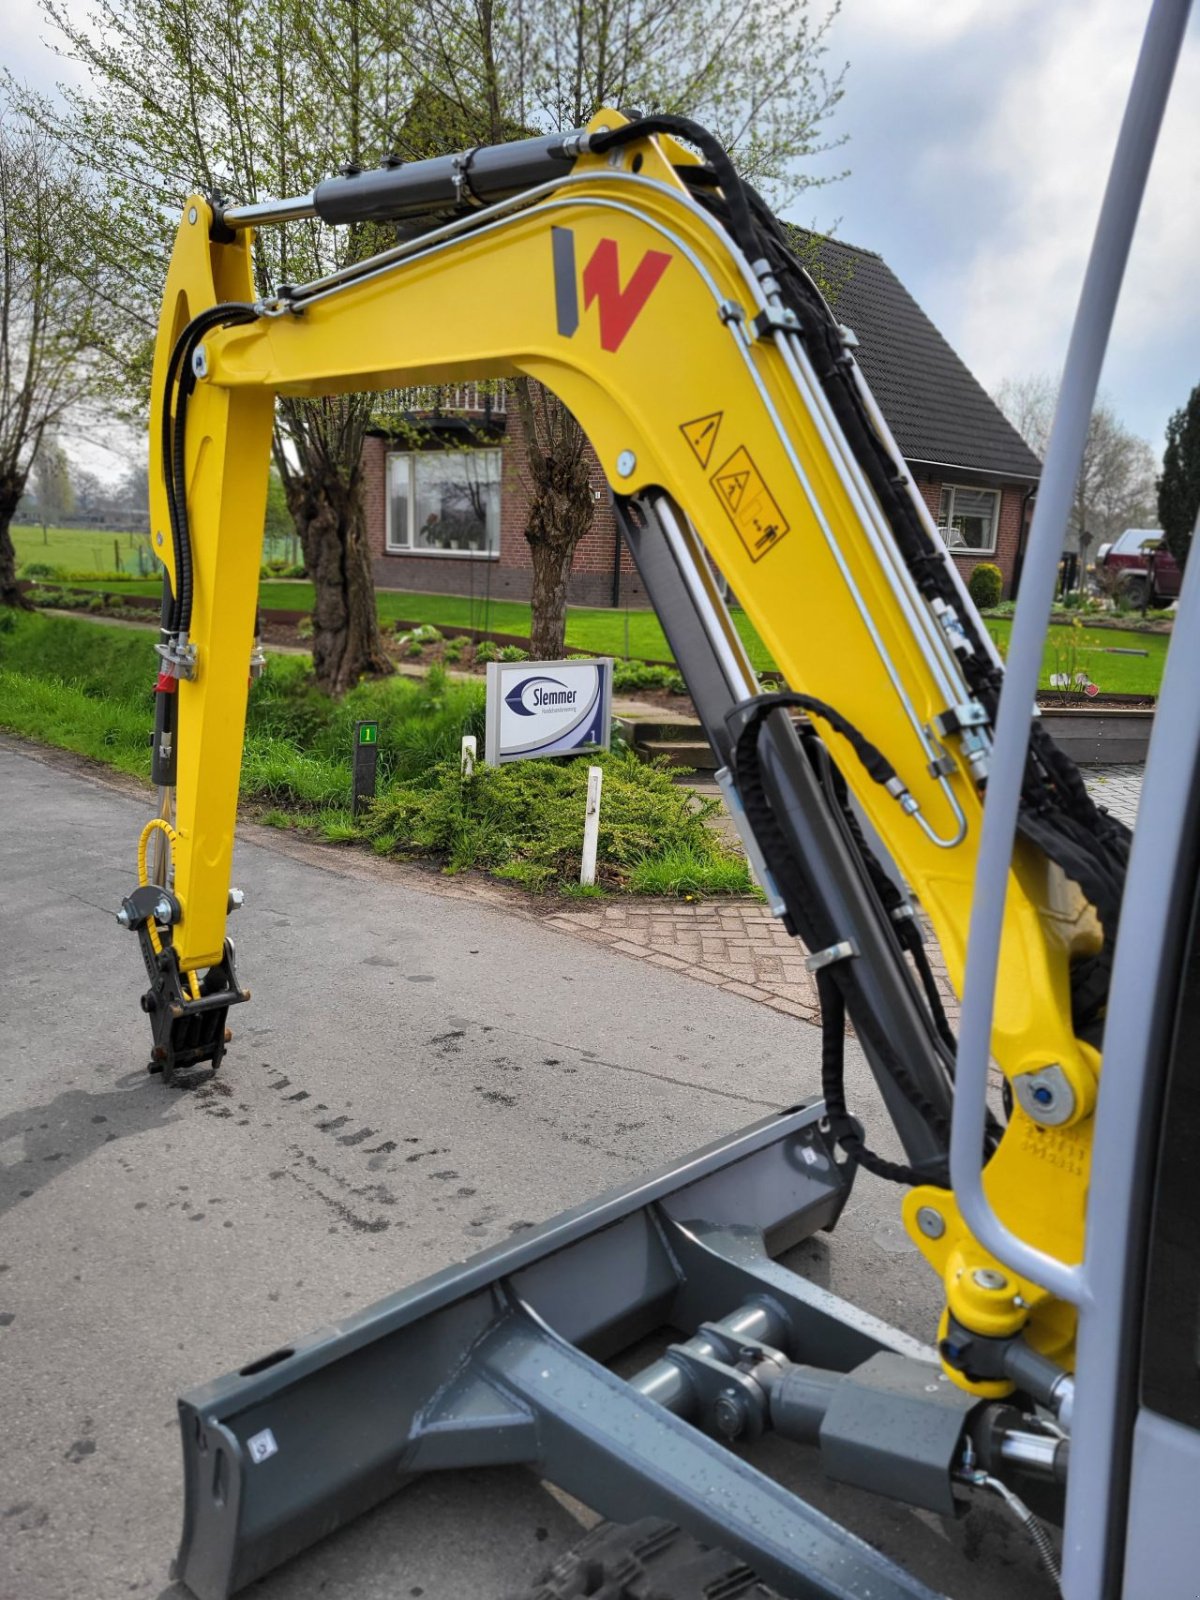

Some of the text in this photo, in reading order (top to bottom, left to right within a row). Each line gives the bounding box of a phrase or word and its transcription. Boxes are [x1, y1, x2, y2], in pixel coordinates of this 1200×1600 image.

[533, 687, 577, 706] Slemmer
[365, 728, 371, 741] 1
[590, 730, 597, 744] 1
